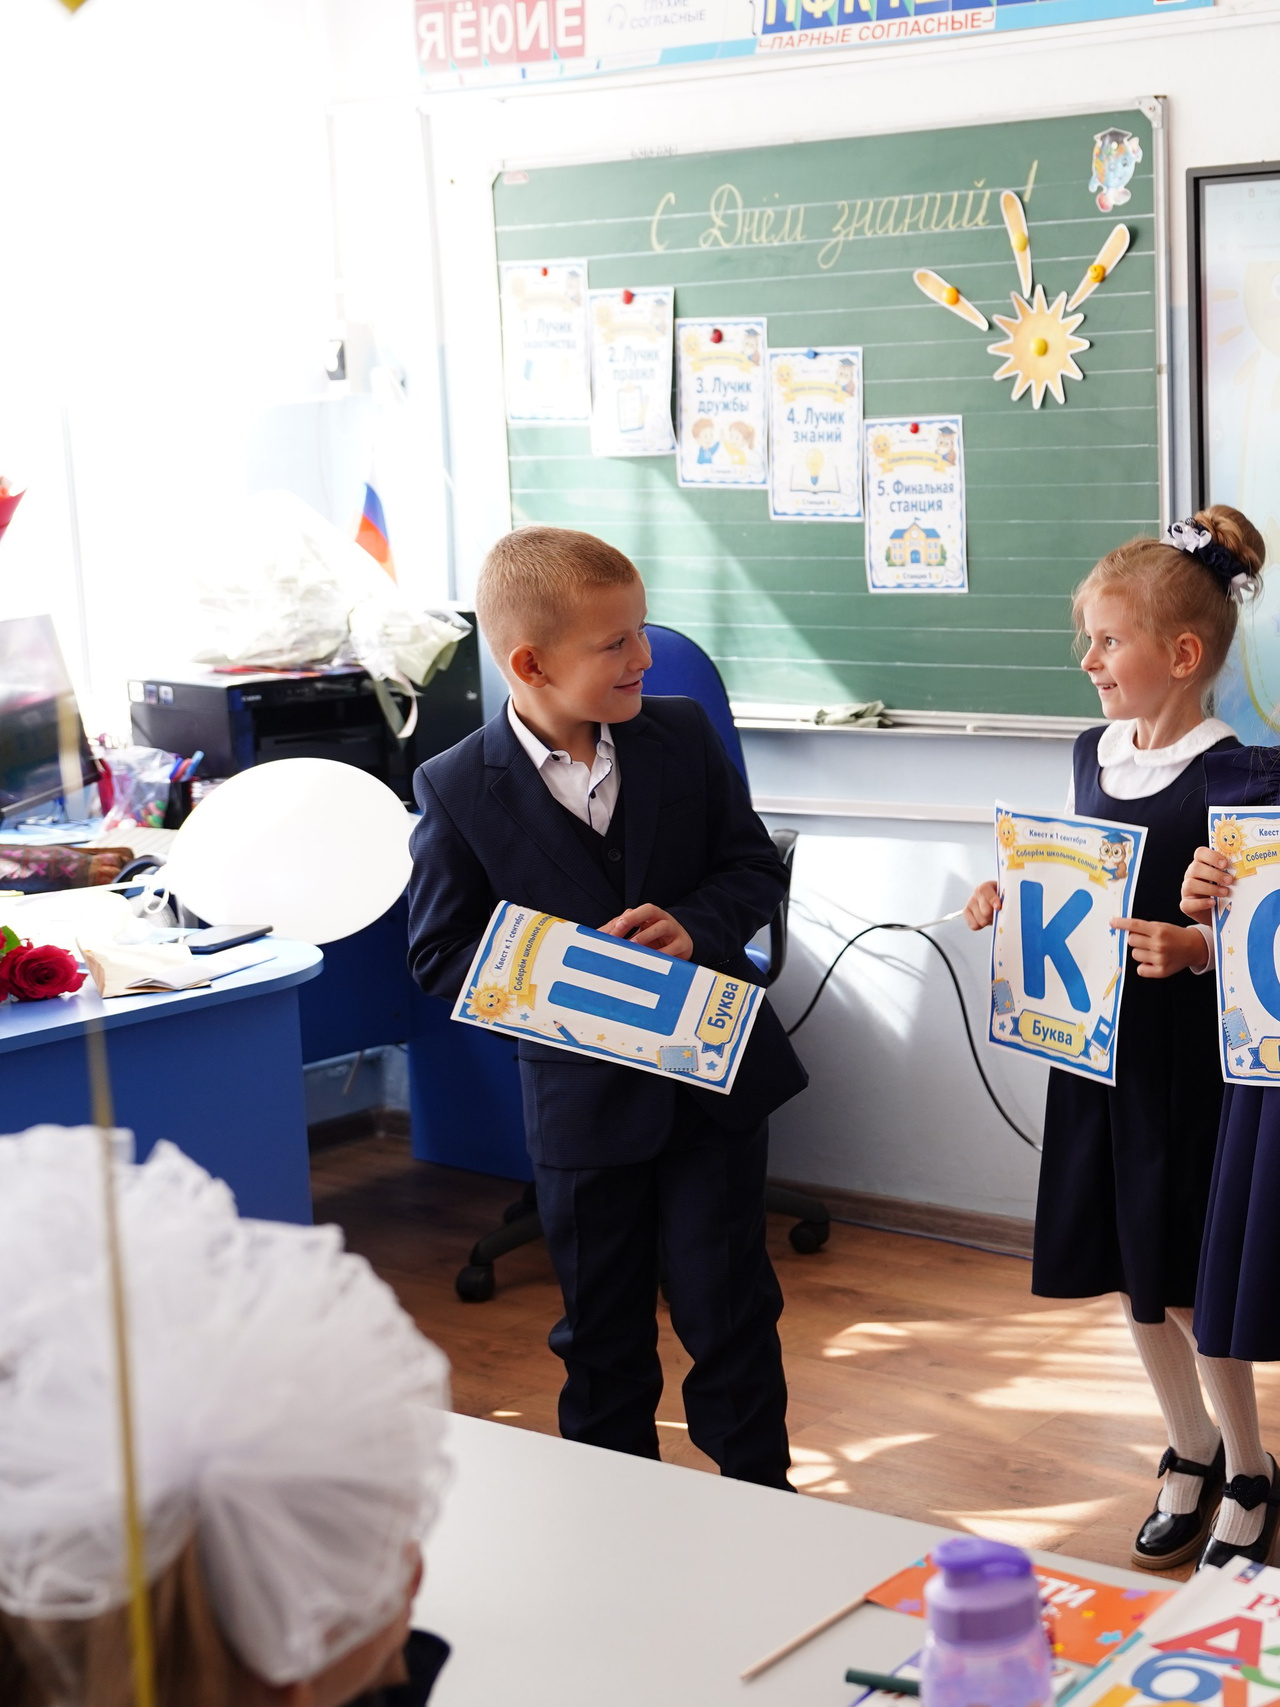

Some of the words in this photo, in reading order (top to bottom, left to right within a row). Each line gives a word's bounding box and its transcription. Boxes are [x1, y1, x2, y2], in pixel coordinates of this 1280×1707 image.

[630, 9, 706, 29] СОГЛАСНЫЕ
[769, 27, 852, 50] ПАРНЫЕ
[858, 12, 983, 41] СОГЛАСНЫЕ
[650, 191, 676, 253] С
[622, 345, 661, 367] Лучик
[695, 376, 709, 394] 3.
[711, 376, 753, 398] Лучик
[697, 396, 750, 416] дружбы
[786, 406, 802, 425] 4.
[803, 406, 845, 429] Лучик
[792, 427, 843, 443] знаний
[876, 479, 890, 497] 5.
[892, 478, 955, 496] Финальная
[889, 499, 944, 514] станция
[1029, 829, 1048, 838] Квест
[1059, 835, 1087, 845] сентября
[1258, 828, 1280, 837] Квест
[1015, 849, 1045, 859] Соберём
[1046, 850, 1077, 861] школьное
[1077, 857, 1099, 871] солнце
[1245, 849, 1278, 862] Соберём
[494, 950, 509, 971] Квест
[509, 912, 525, 939] сентября
[1019, 879, 1094, 1014] К
[513, 959, 527, 992] Соберём
[523, 926, 541, 959] школьное
[547, 924, 700, 1036] Ш
[707, 981, 739, 1030] Буква
[1032, 1018, 1073, 1046] Буква
